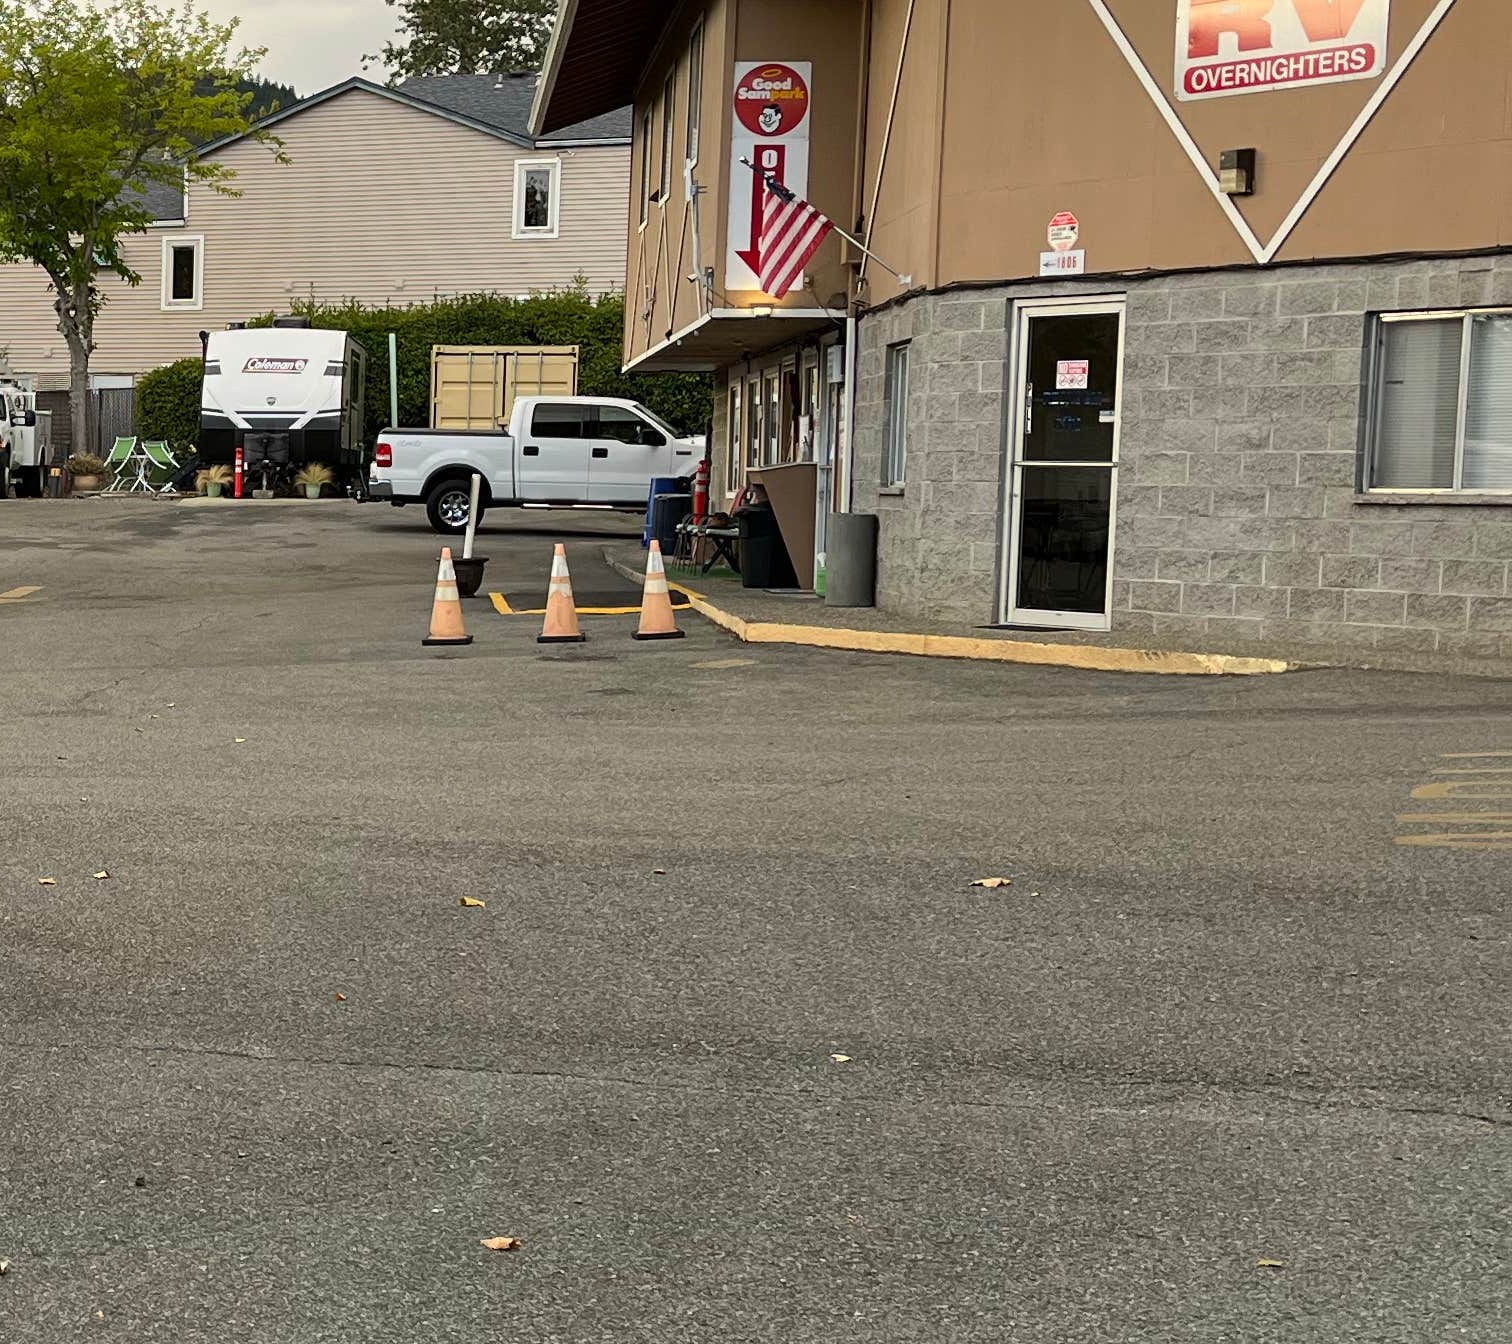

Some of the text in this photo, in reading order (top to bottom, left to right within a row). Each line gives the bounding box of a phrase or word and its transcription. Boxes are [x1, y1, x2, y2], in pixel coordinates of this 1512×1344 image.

[1191, 47, 1368, 91] OVERNIGHTERS
[752, 77, 792, 90] Good
[247, 358, 295, 370] Coleman
